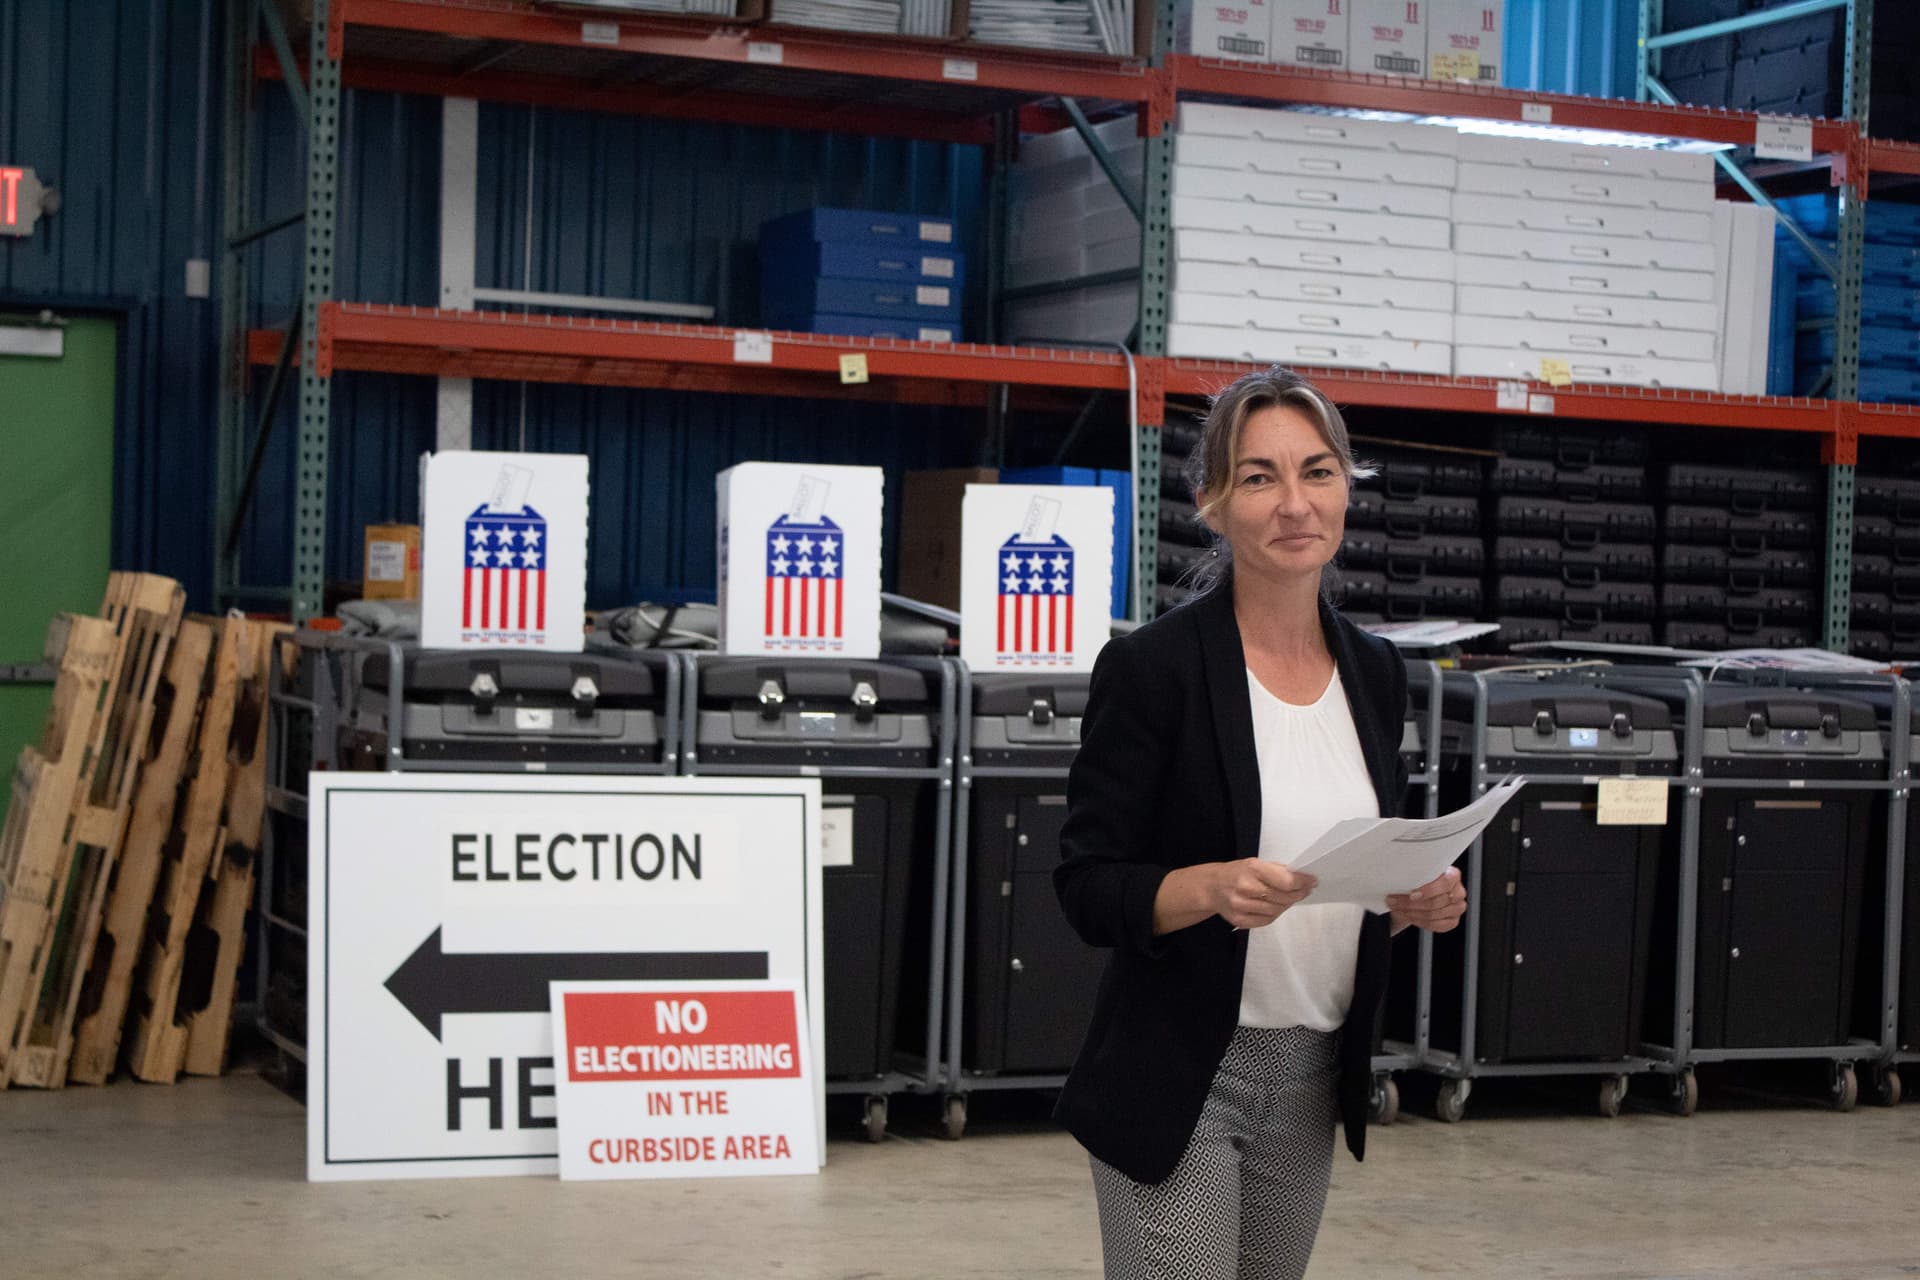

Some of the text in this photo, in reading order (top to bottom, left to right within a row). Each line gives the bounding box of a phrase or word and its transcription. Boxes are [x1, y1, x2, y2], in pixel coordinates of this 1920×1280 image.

[453, 833, 702, 881] ELECTION
[655, 1000, 708, 1034] NO
[574, 1043, 793, 1073] ELECTIONEERING
[446, 1057, 557, 1131] HE
[647, 1090, 729, 1116] IN THE
[588, 1134, 792, 1164] CURBSIDE AREA
